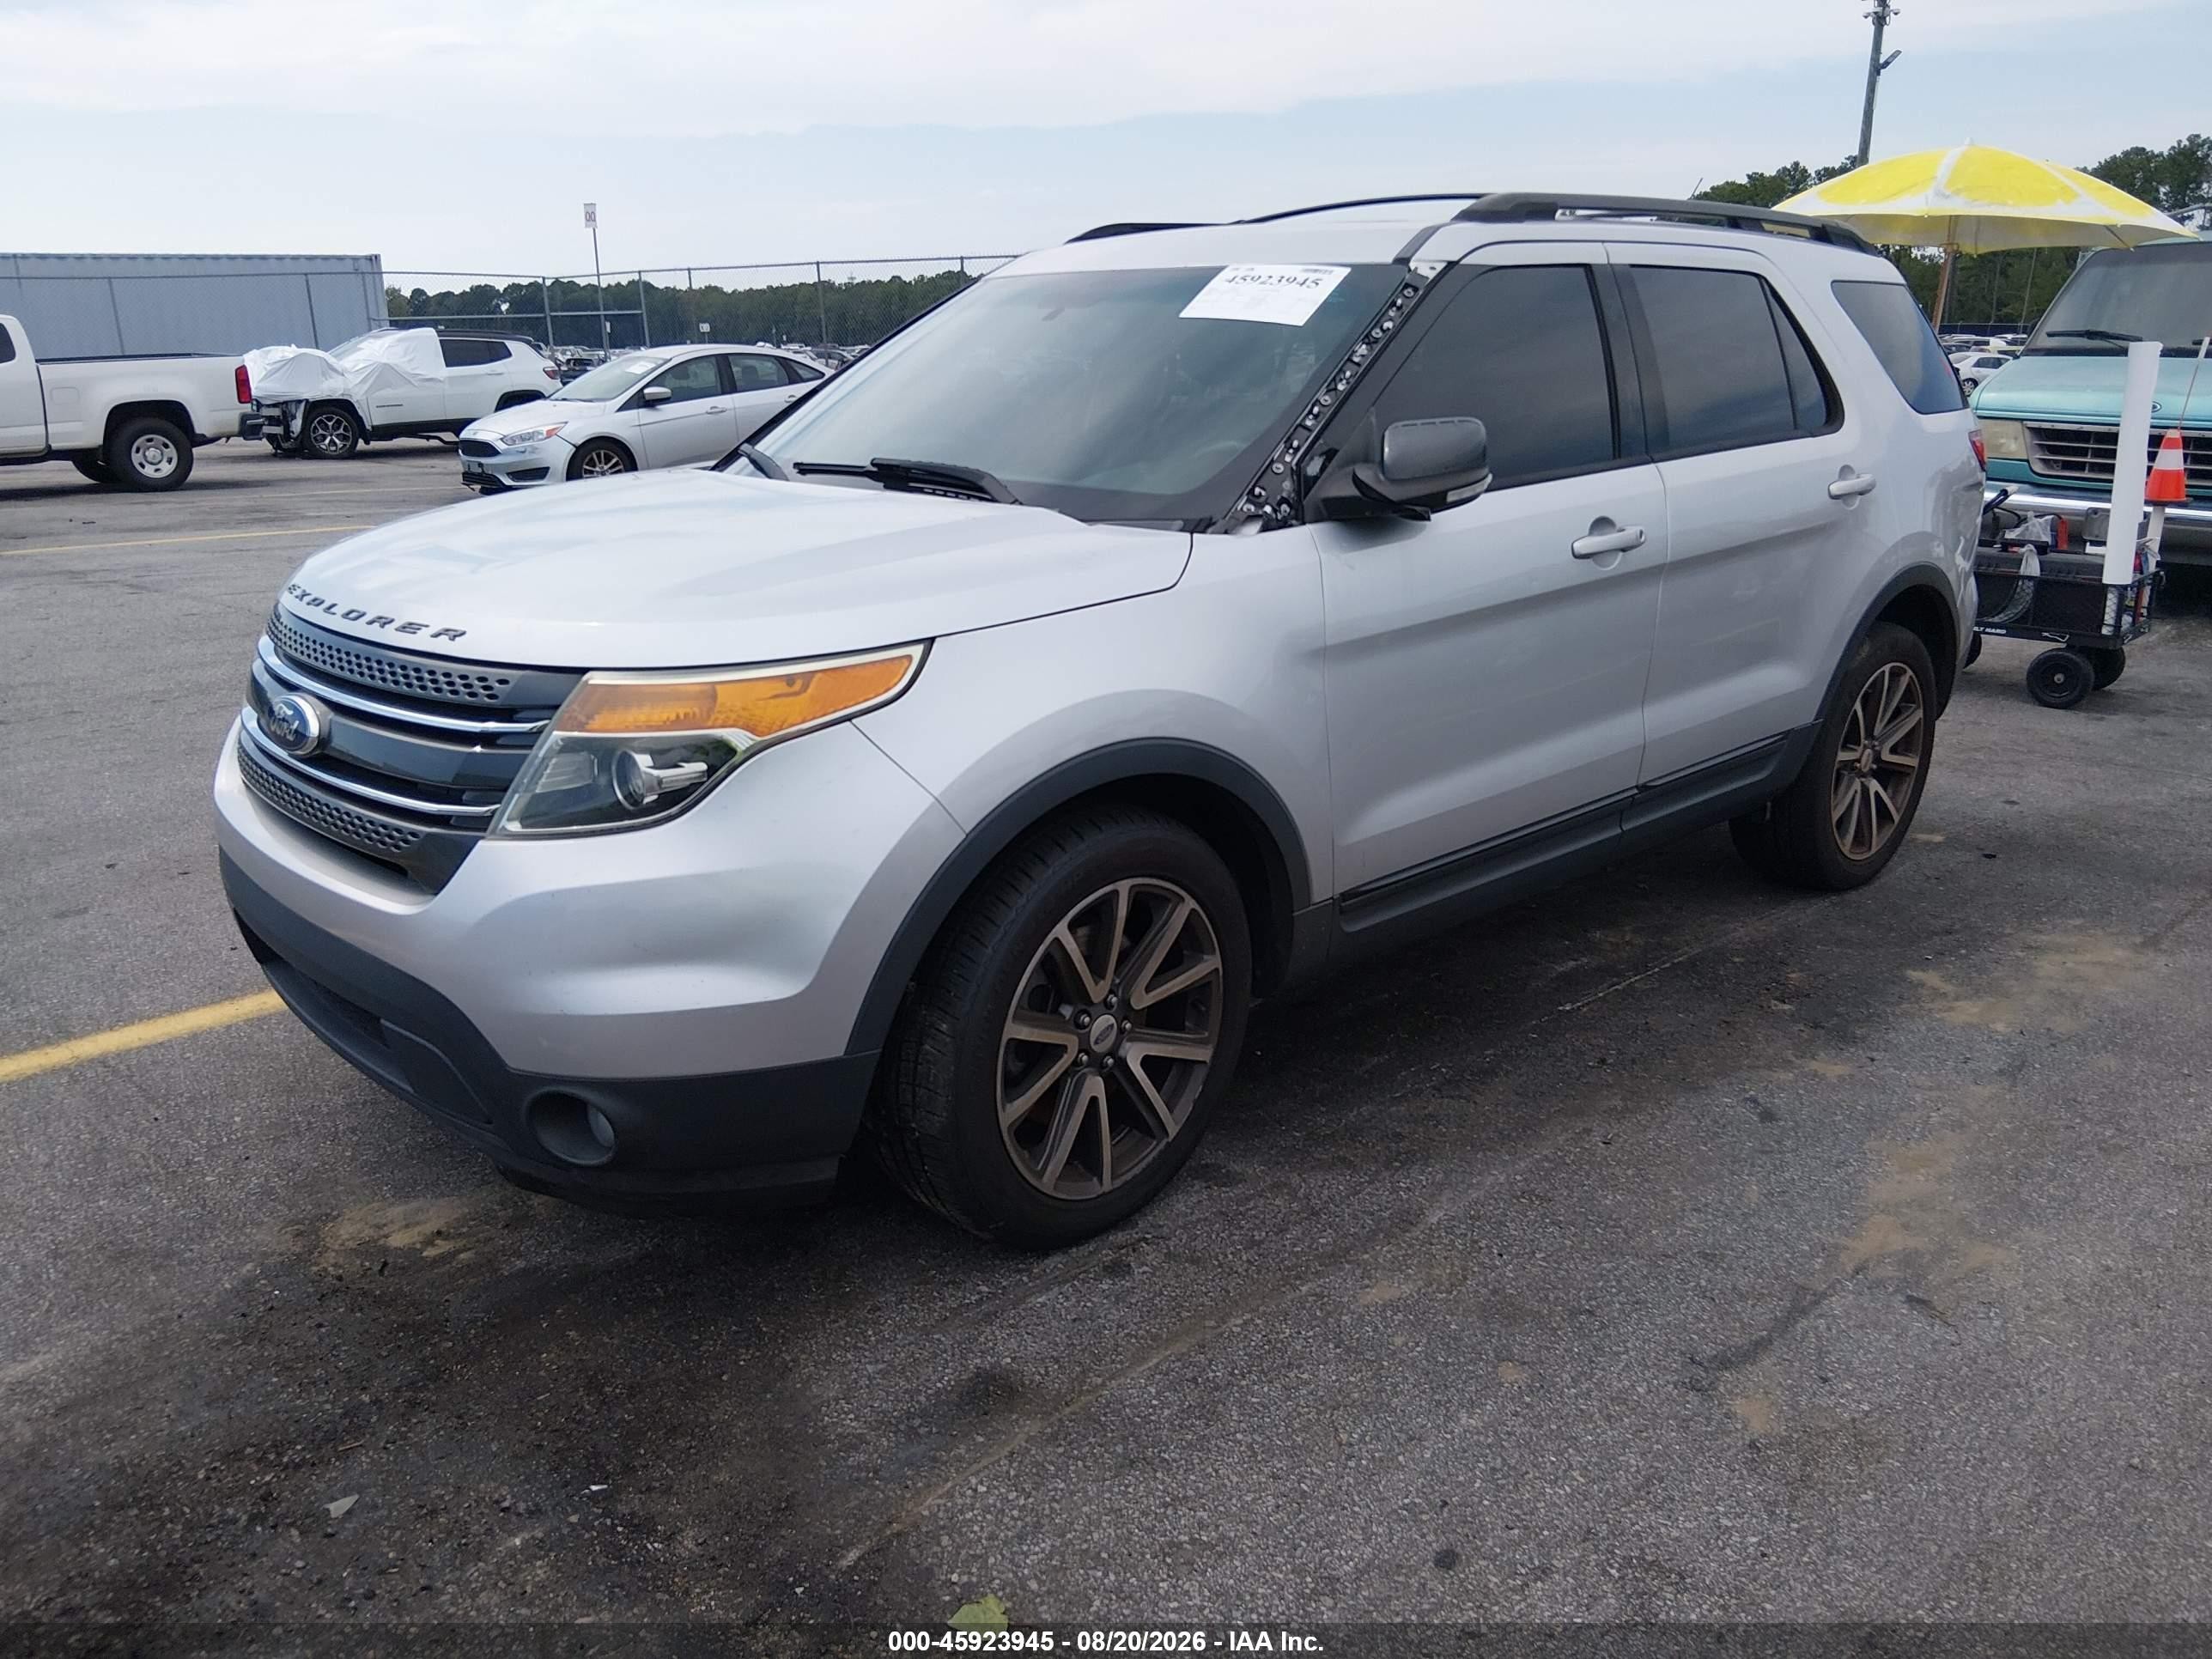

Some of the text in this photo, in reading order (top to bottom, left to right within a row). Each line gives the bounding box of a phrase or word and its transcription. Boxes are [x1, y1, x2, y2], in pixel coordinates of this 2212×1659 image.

[1224, 275, 1324, 289] 45923945
[287, 584, 467, 642] EXPLORER
[270, 702, 300, 742] Ford
